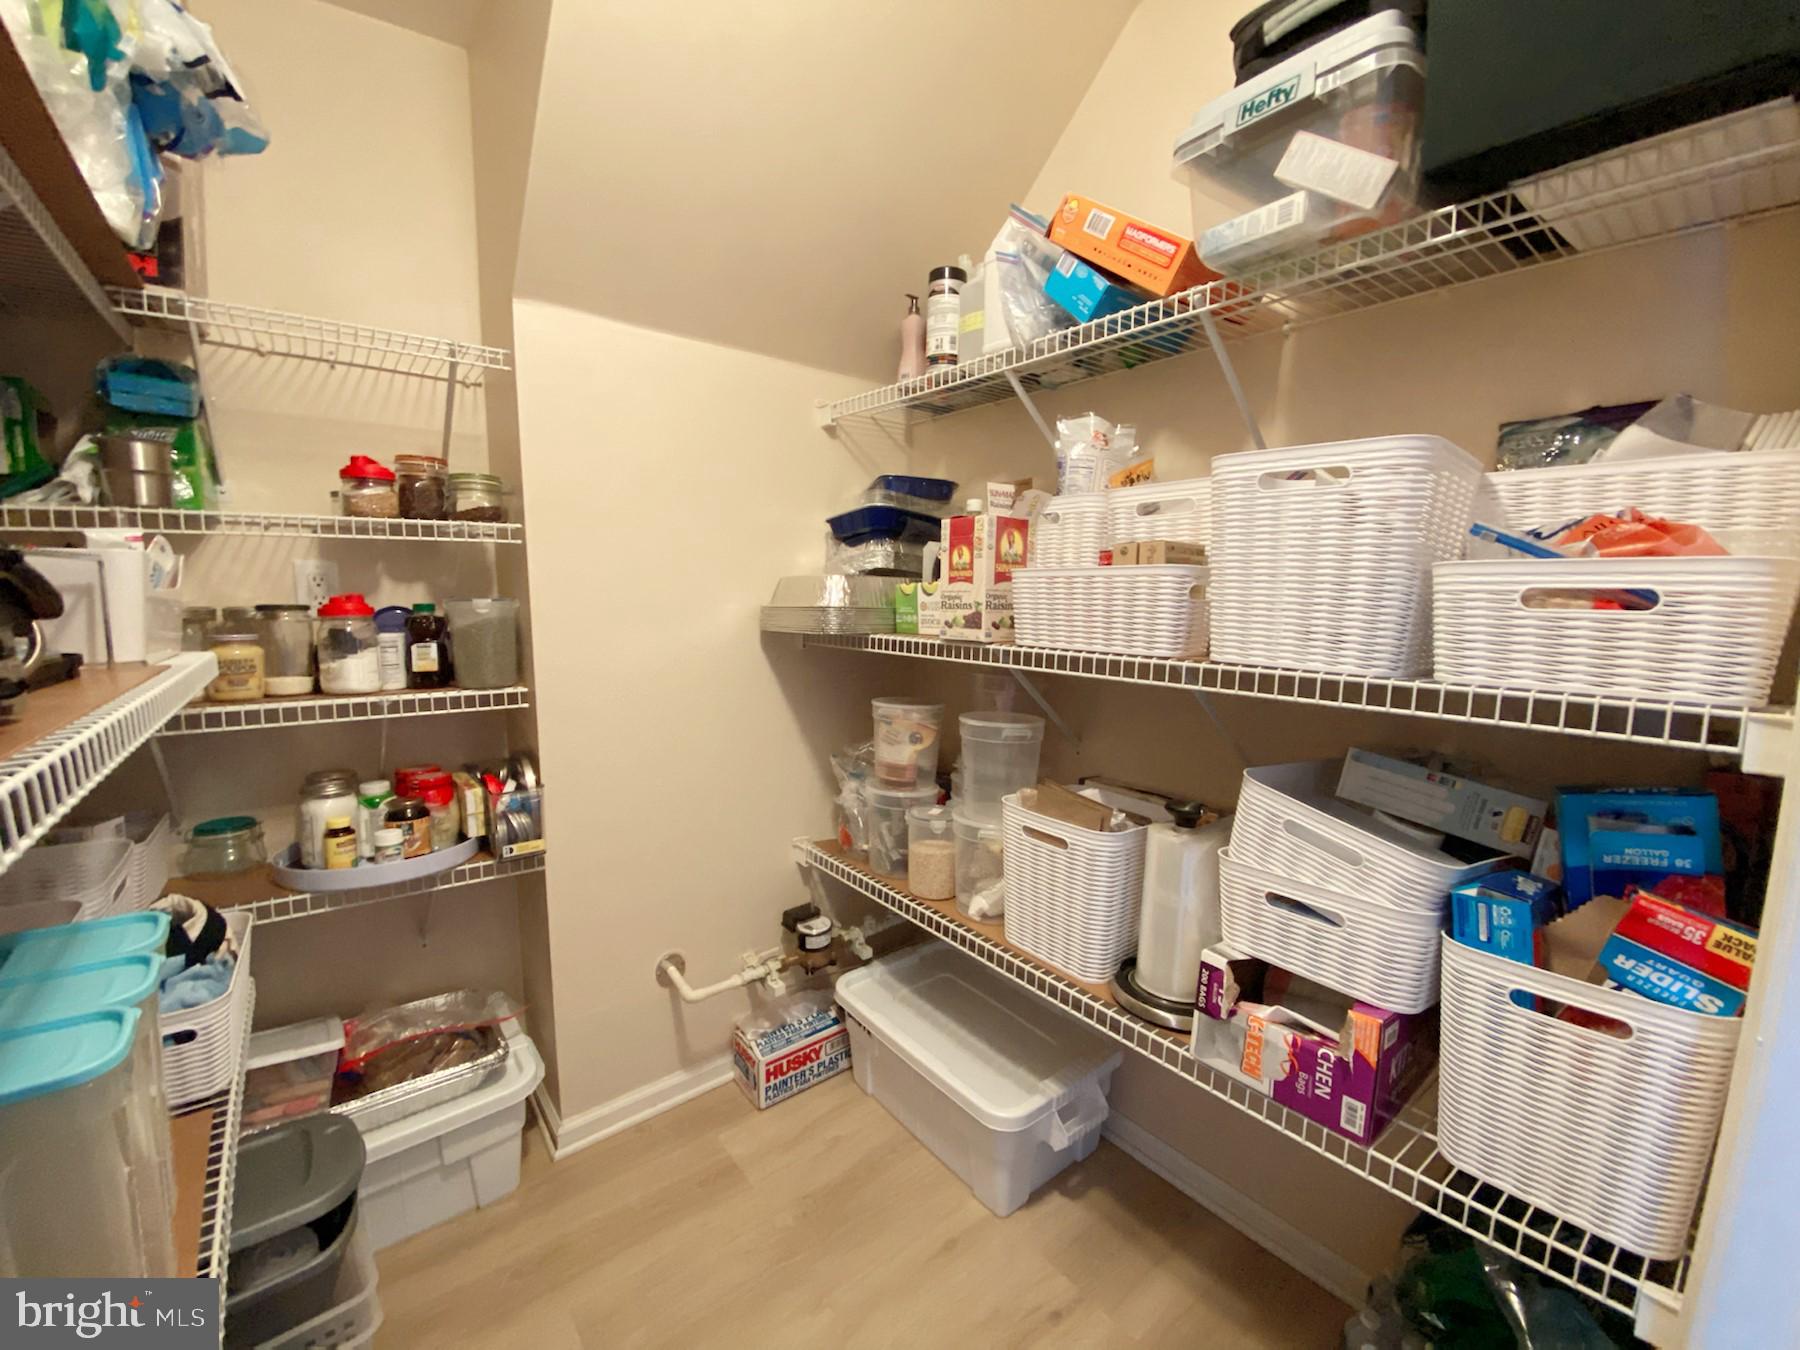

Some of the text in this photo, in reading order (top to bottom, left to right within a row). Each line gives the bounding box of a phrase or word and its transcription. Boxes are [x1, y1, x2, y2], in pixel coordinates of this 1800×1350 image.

[1241, 84, 1296, 121] Hefty
[941, 600, 973, 610] Raisins
[985, 600, 1013, 610] Raisin
[1603, 854, 1669, 867] FREEZER
[1625, 848, 1669, 857] GALLON
[1681, 927, 1706, 946] 35
[1722, 932, 1756, 951] ACK
[1711, 939, 1754, 963] ALUE
[1613, 953, 1724, 1014] SLIDER
[1646, 958, 1704, 988] QUART
[1198, 968, 1210, 1009] 200 BAGS
[765, 1045, 823, 1084] HUSKY
[1314, 1048, 1335, 1100] CHEN
[765, 1066, 815, 1097] PAINTER'S
[1296, 1071, 1309, 1095] Bags
